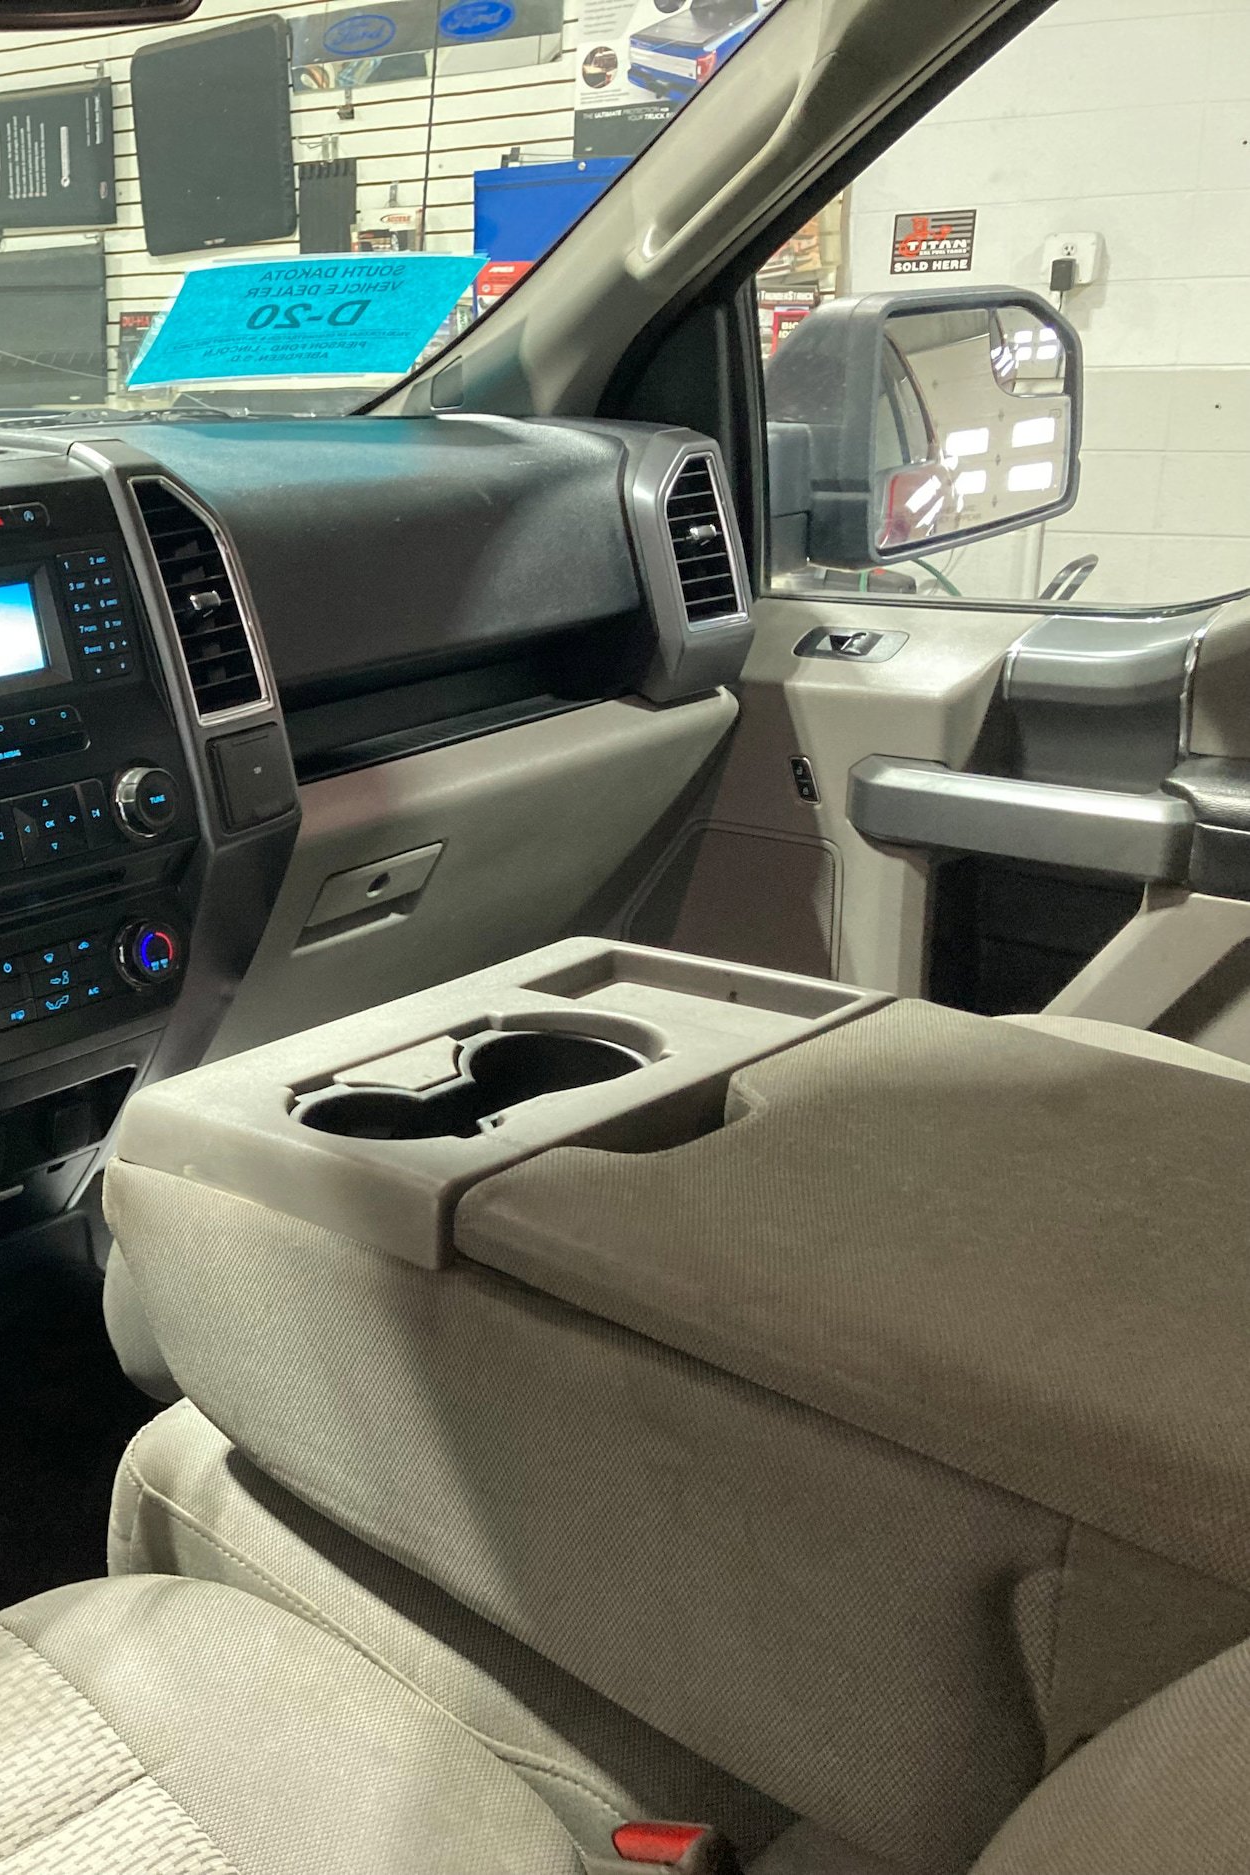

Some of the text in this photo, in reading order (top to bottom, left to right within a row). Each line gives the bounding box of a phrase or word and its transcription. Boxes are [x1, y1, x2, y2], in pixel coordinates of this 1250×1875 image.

[594, 109, 622, 118] ULTIMATE
[644, 112, 665, 120] TRUCK
[907, 239, 967, 251] TITAN
[893, 259, 968, 272] SOLD HERE
[149, 794, 166, 804] TUNE
[44, 819, 56, 829] OK
